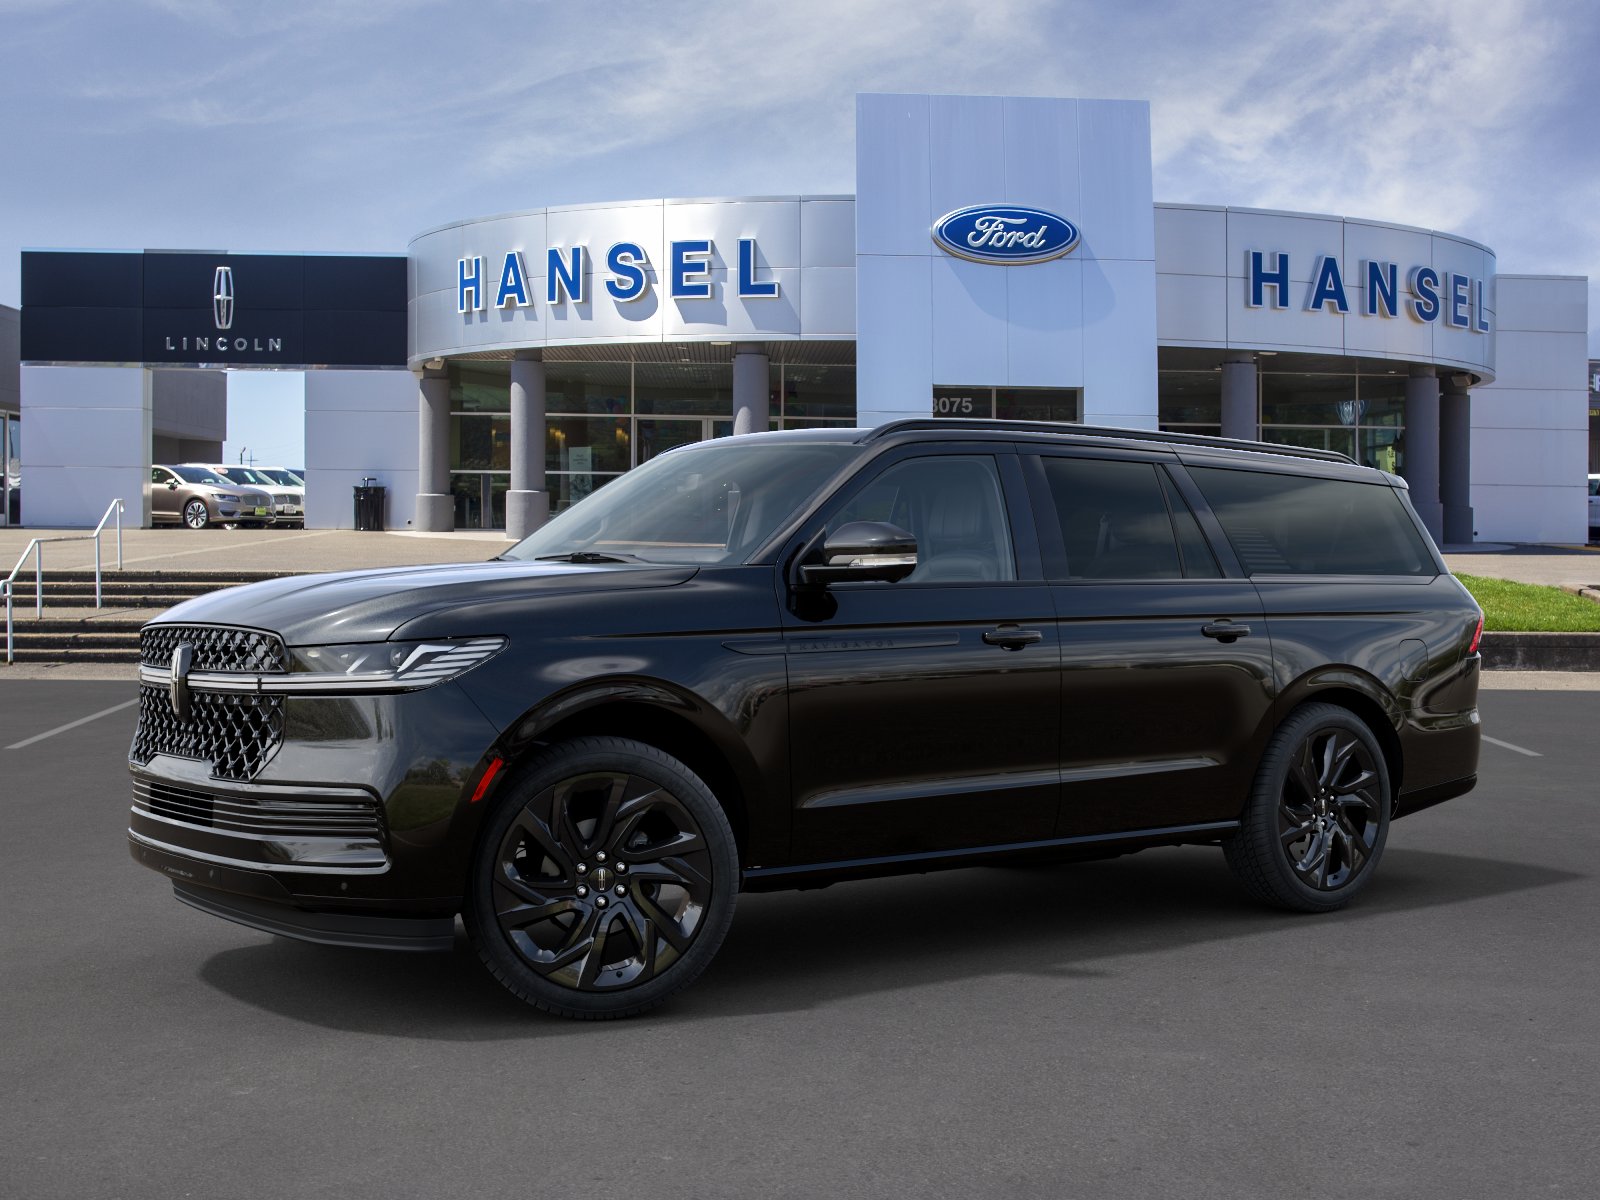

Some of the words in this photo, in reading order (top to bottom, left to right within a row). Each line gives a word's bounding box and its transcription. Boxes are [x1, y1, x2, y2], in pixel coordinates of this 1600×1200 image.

[967, 215, 1048, 248] Ford
[457, 237, 779, 313] HANSEL
[1247, 249, 1490, 334] HANSEL
[165, 336, 282, 352] LINCOLN
